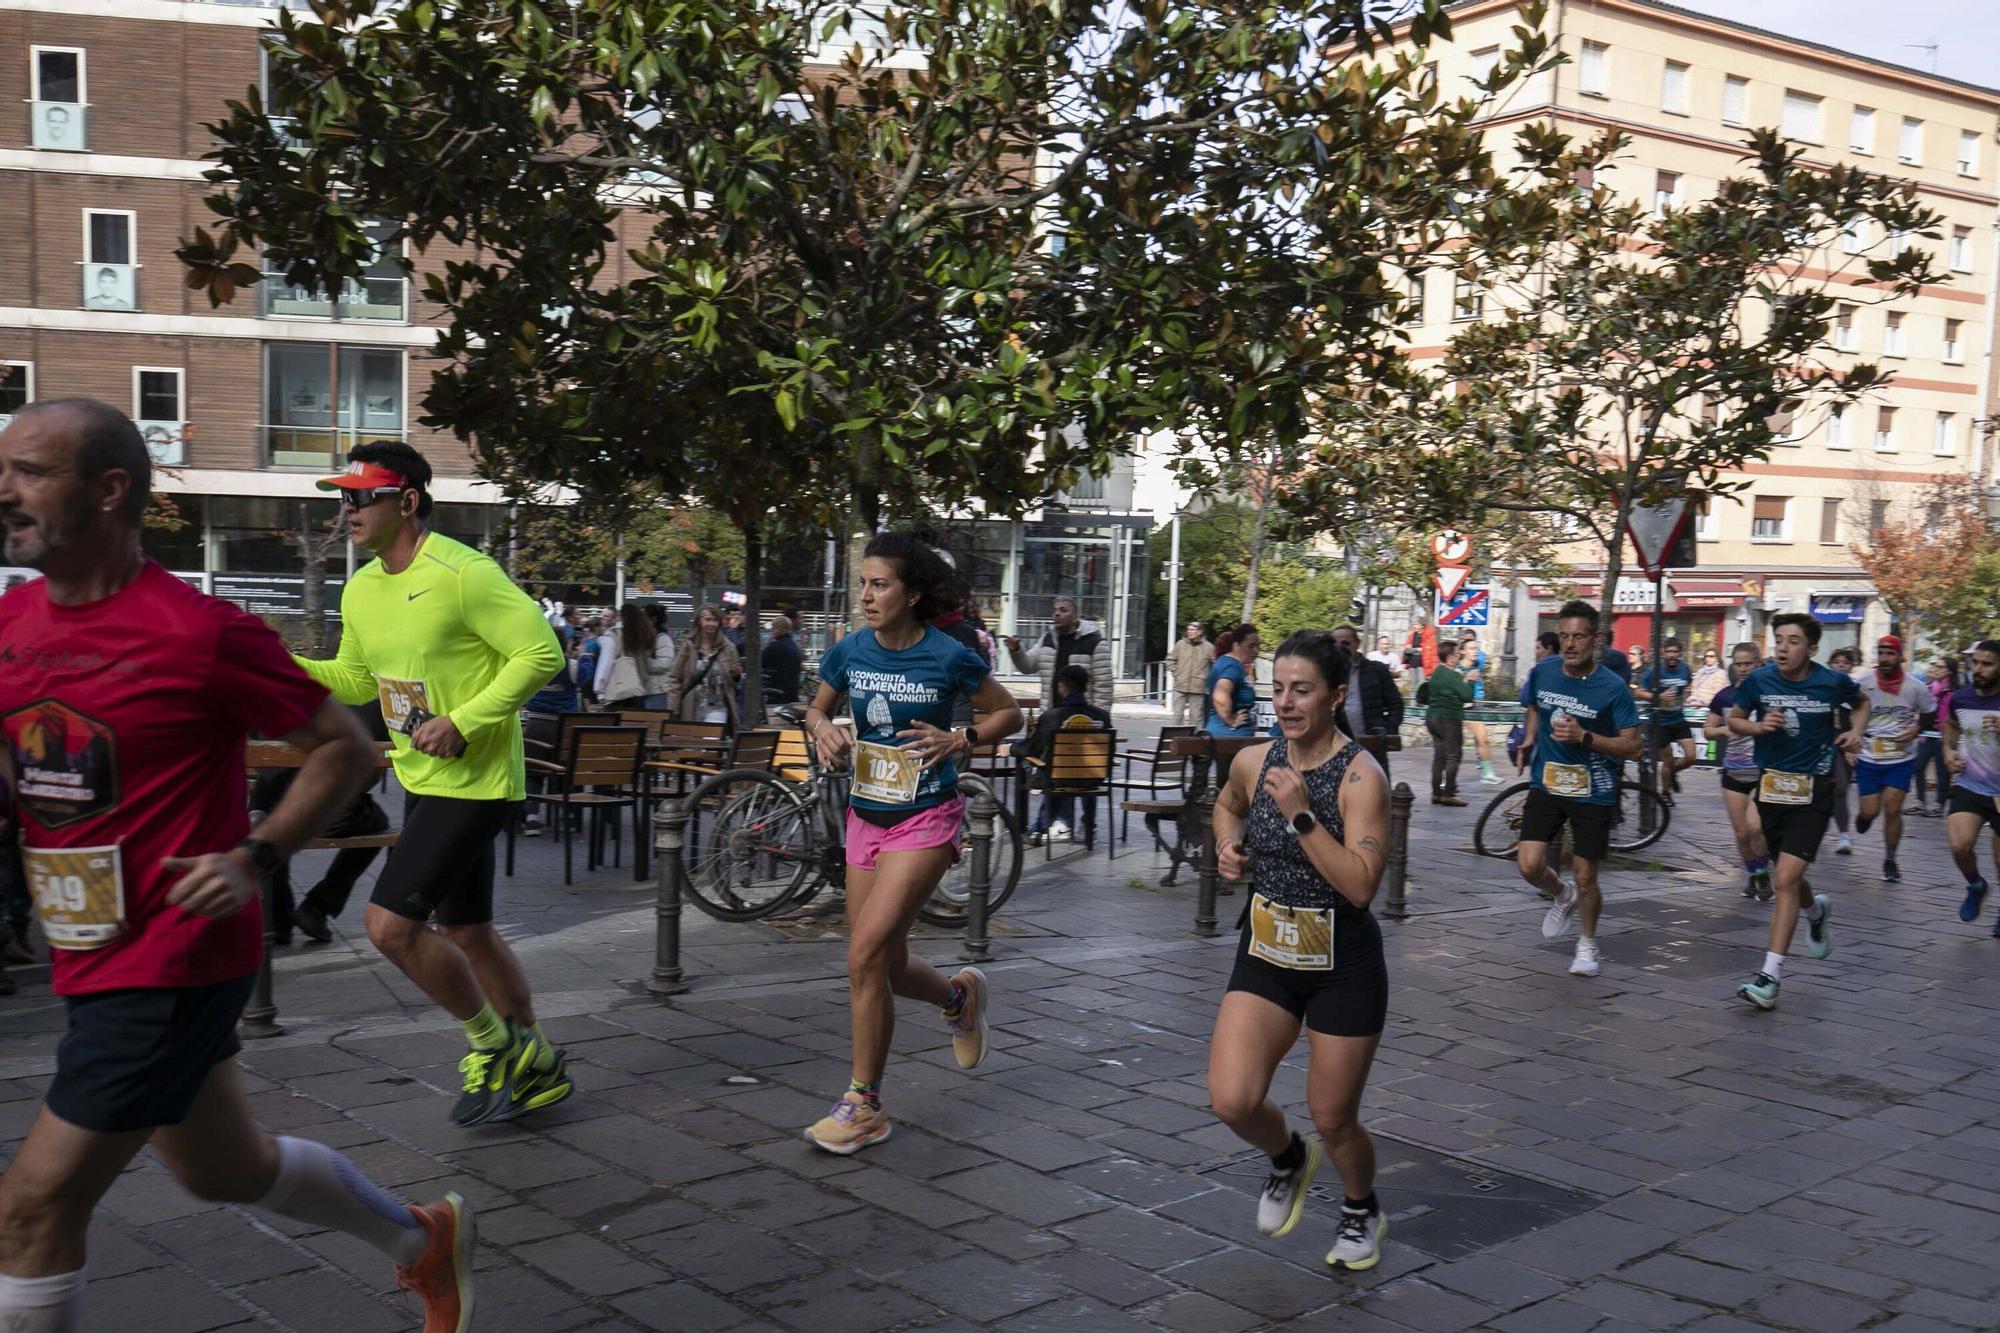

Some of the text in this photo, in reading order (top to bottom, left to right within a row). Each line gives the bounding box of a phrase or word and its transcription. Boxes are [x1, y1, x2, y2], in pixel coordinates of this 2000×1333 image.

[854, 670, 906, 683] CONQUISTA
[855, 679, 926, 694] ALMENDRA
[389, 692, 411, 716] 165
[889, 692, 938, 703] KONKISTA
[869, 758, 899, 783] 102
[31, 875, 87, 912] 549
[1273, 919, 1300, 946] 75
